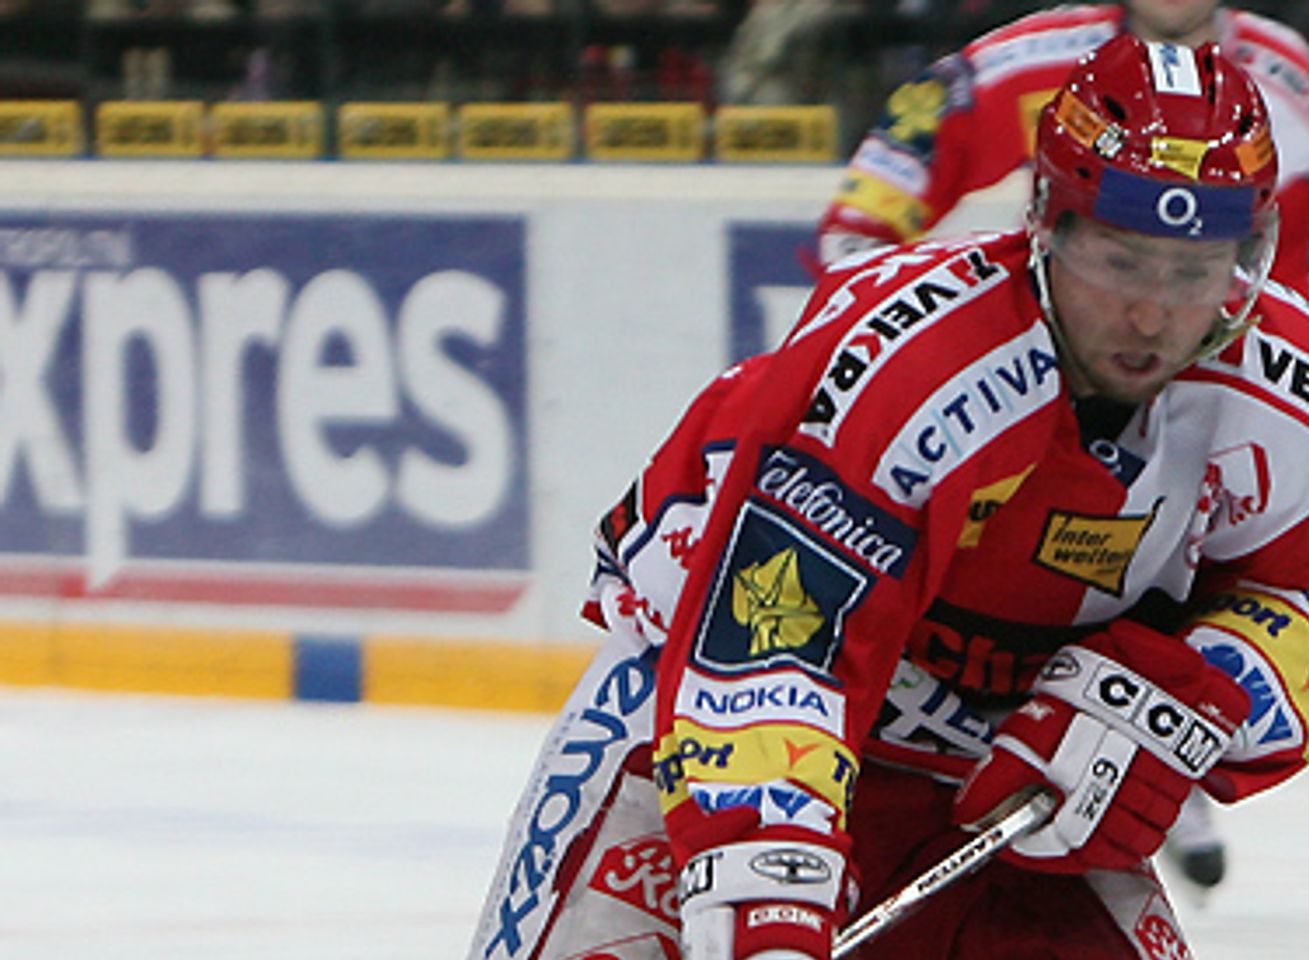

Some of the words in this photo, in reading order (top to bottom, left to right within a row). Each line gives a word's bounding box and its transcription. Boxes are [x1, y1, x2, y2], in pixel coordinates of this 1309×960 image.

[890, 347, 1058, 497] ACTIVA
[694, 684, 830, 717] NOKIA
[1098, 672, 1226, 774] CCM
